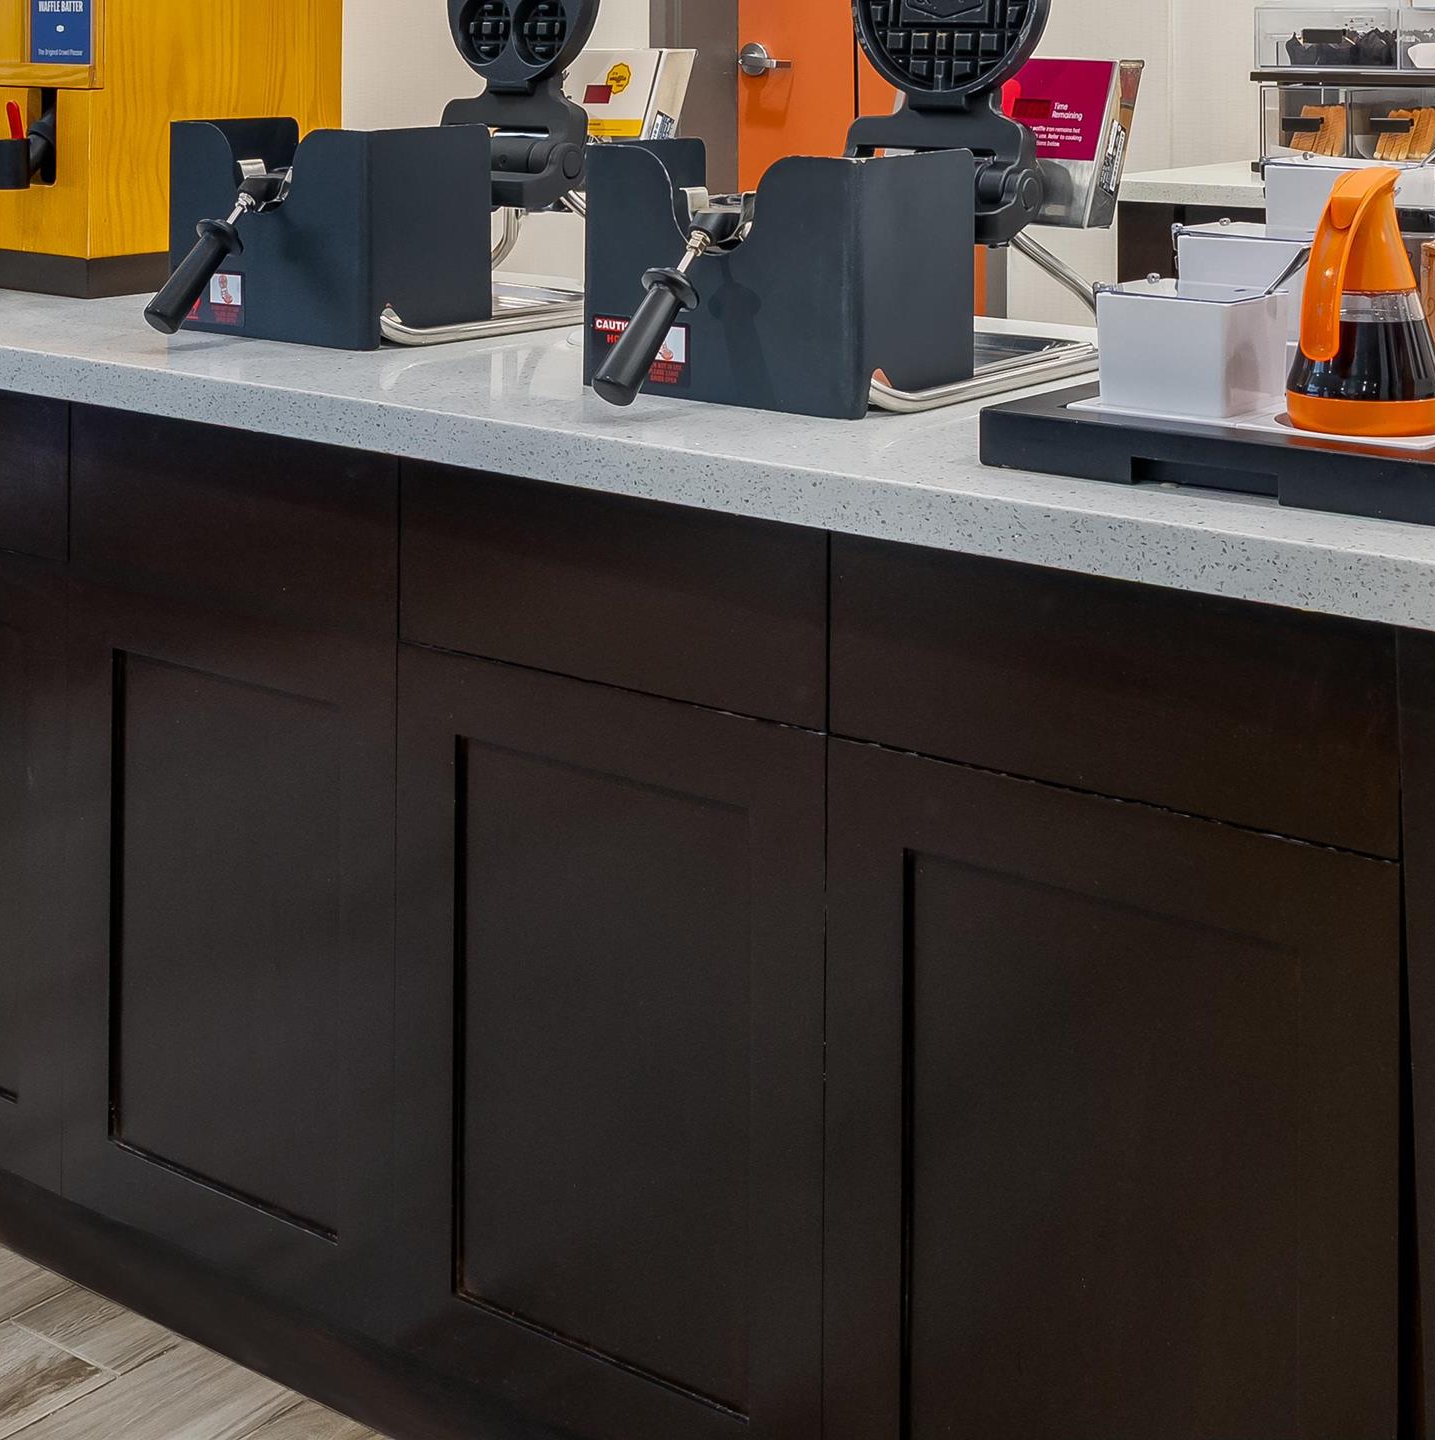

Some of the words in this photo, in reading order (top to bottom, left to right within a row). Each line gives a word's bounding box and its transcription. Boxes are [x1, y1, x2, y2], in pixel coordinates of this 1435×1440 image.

[38, 0, 61, 13] WAFFLE
[61, 1, 84, 13] BATTER
[1053, 102, 1069, 111] Time
[1051, 110, 1083, 122] Remaining
